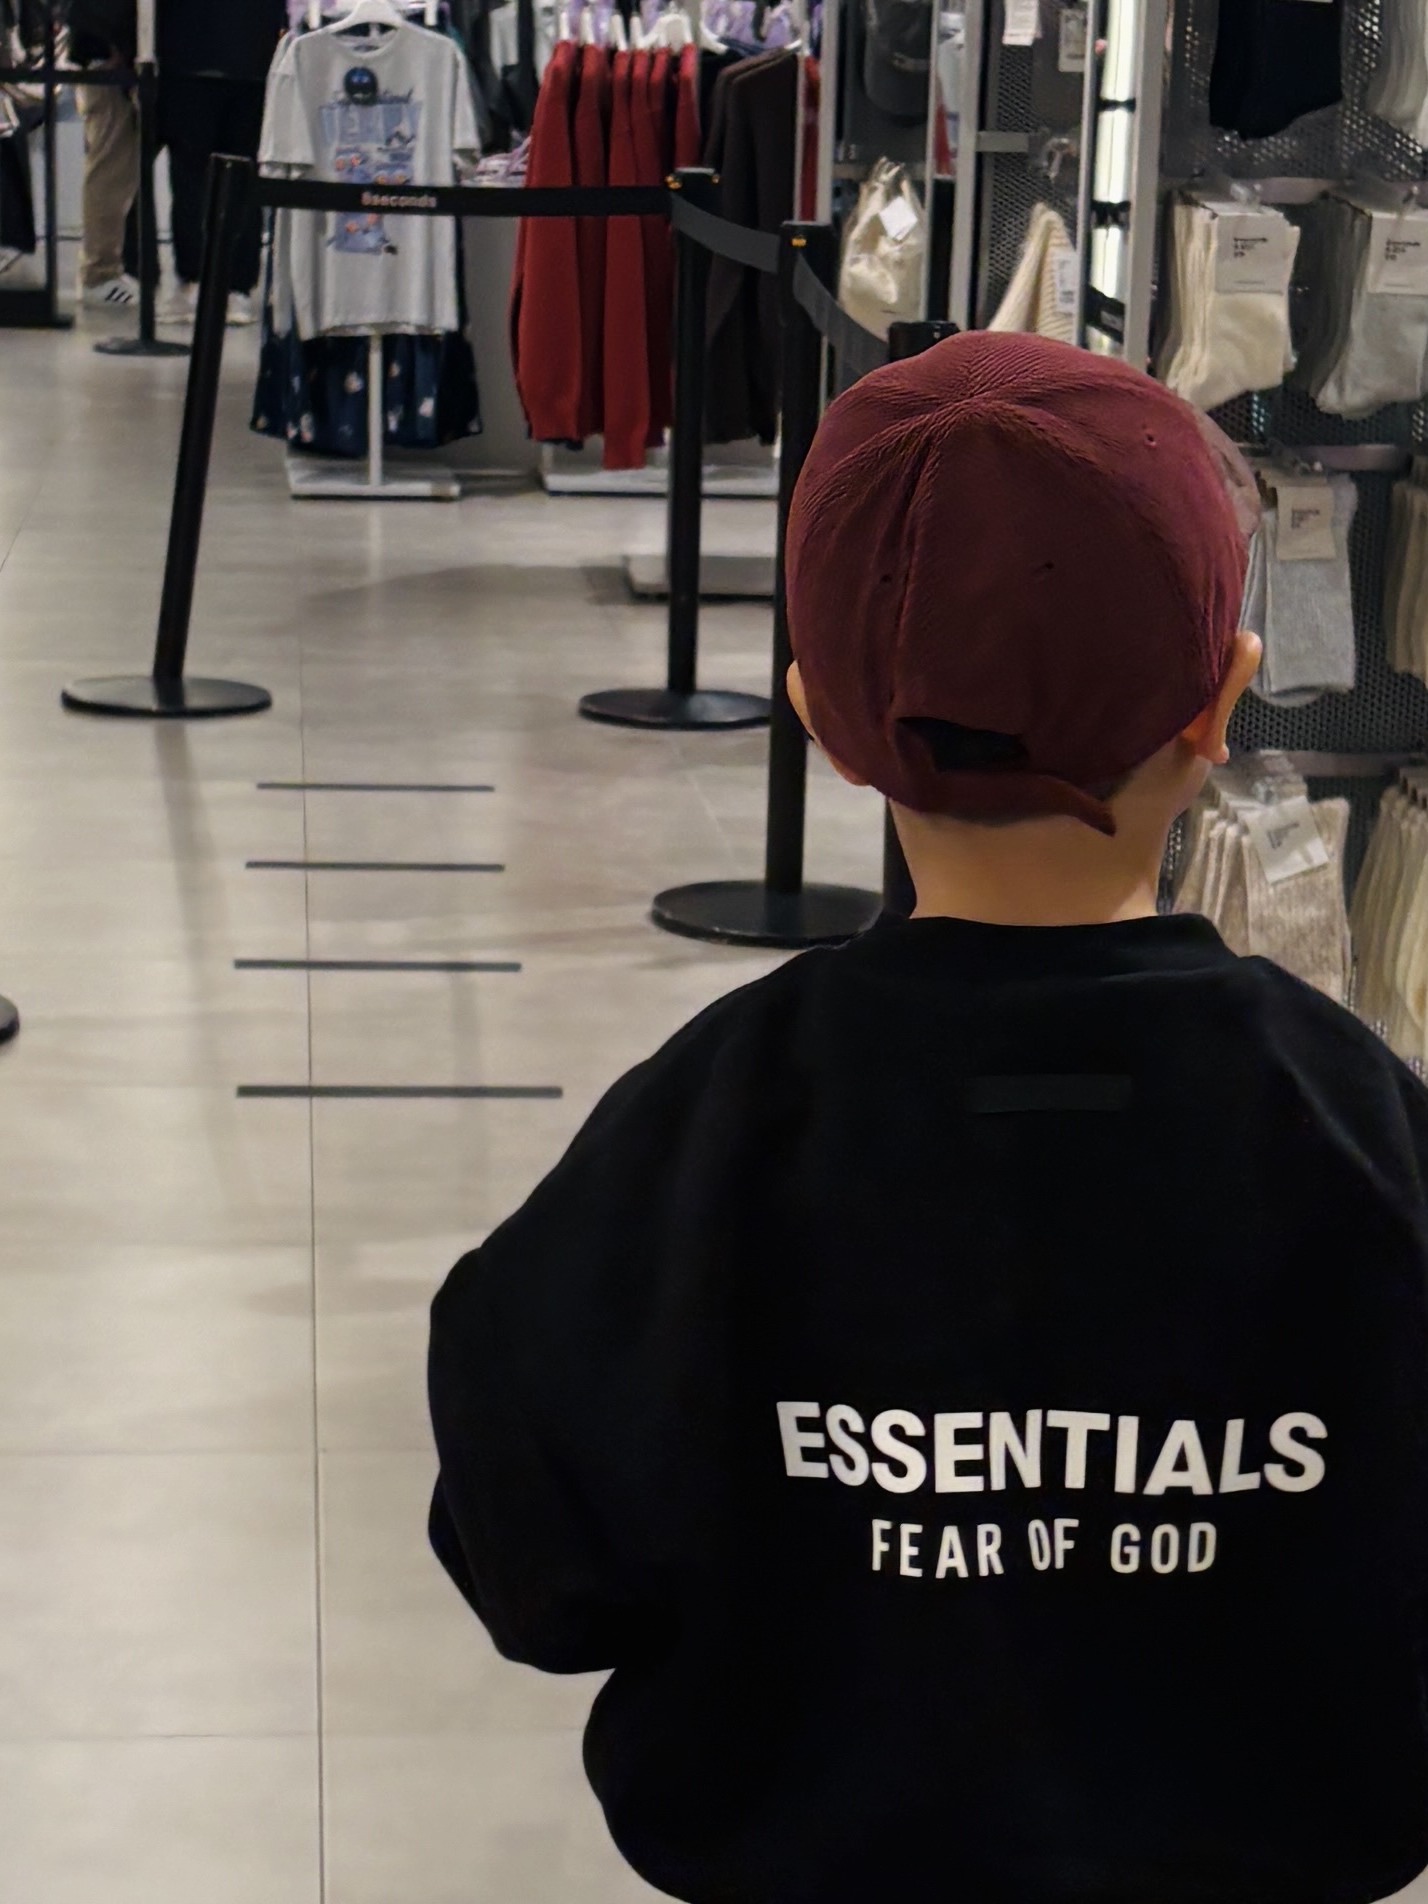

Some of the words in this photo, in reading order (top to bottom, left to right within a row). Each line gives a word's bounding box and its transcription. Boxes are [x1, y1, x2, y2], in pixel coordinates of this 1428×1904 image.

[777, 1402, 1327, 1495] ESSENTIALS
[872, 1519, 1004, 1578] FEAR
[1028, 1518, 1079, 1570] OF
[1111, 1522, 1216, 1573] GOD
